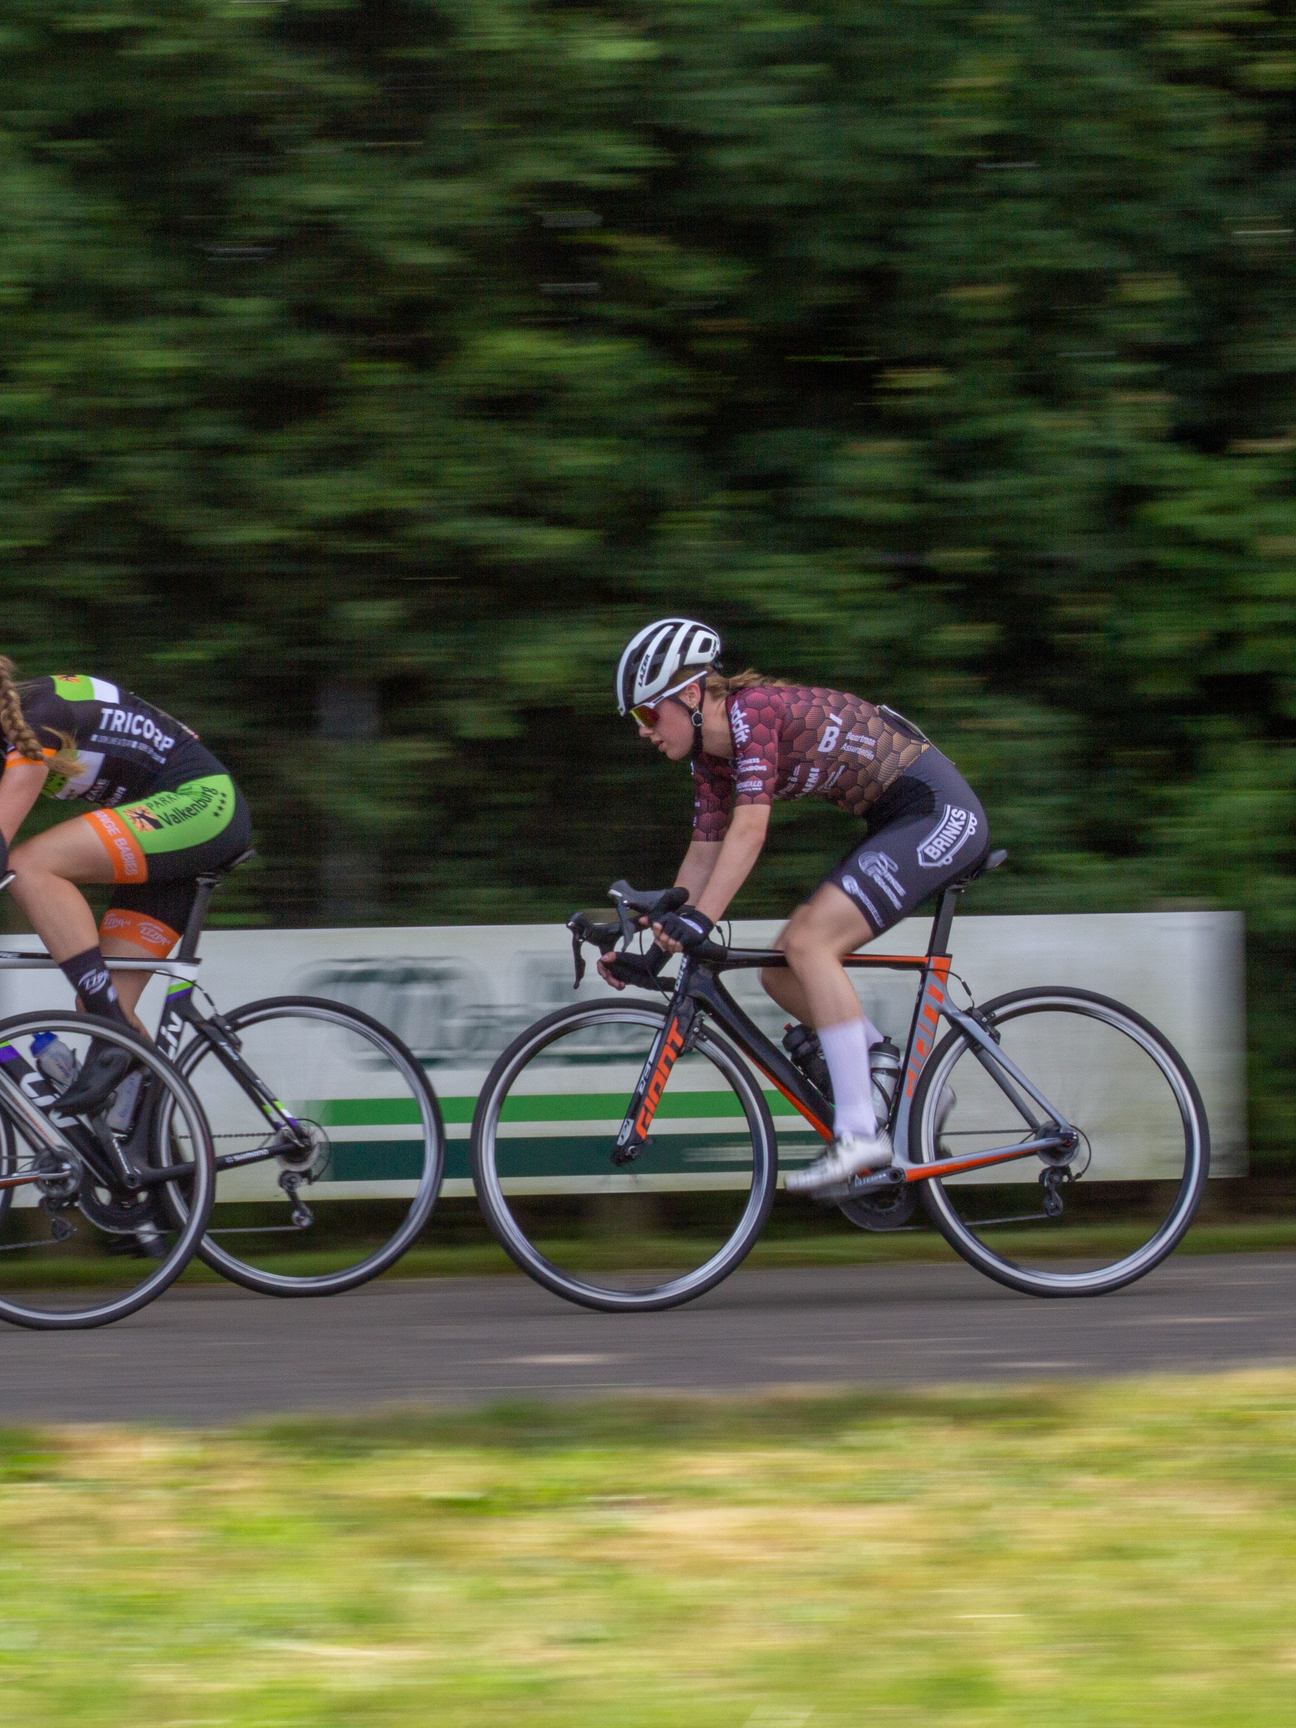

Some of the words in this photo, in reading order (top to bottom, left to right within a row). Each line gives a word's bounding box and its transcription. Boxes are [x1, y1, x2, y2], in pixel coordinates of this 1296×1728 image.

[637, 653, 651, 688] LAZER
[99, 707, 175, 752] TRICORP
[113, 837, 139, 876] BABIES
[923, 808, 967, 861] BRINKS
[635, 1016, 684, 1141] GIANT
